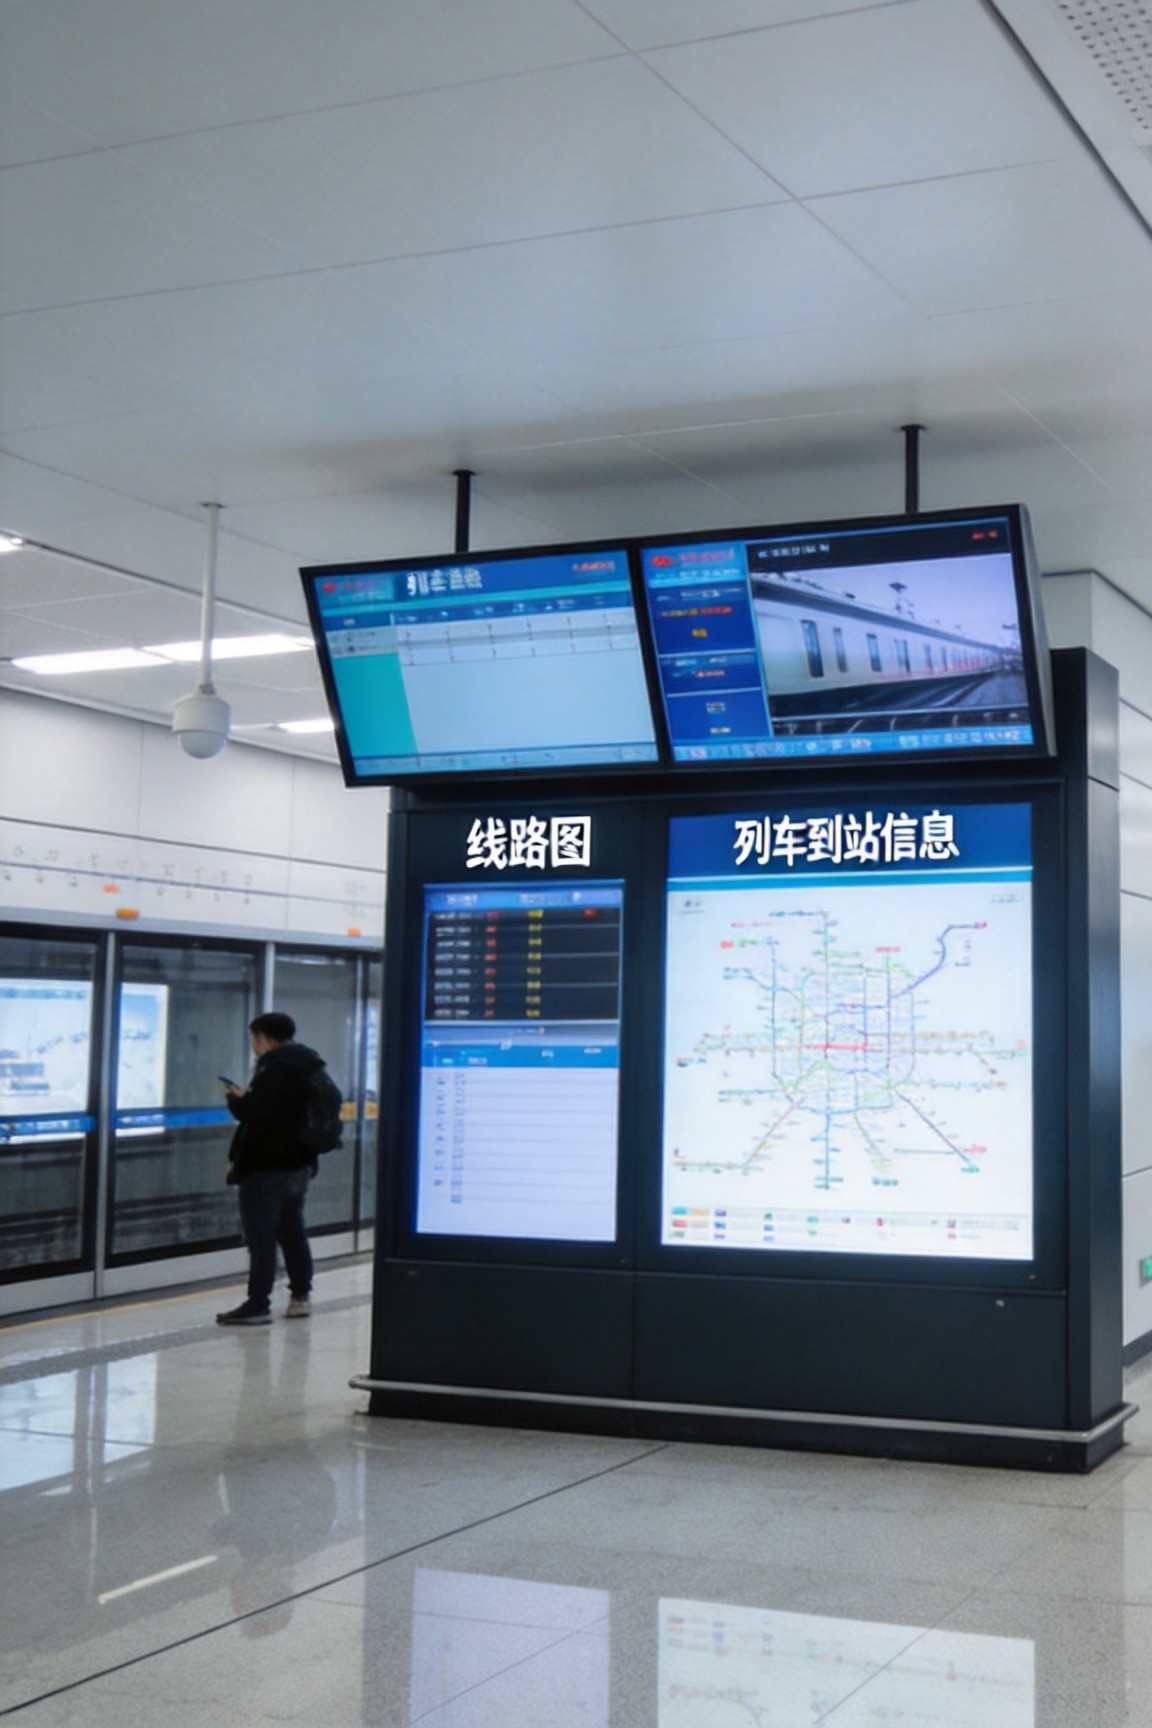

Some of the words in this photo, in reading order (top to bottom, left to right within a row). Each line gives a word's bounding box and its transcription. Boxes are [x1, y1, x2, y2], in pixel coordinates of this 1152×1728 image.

[466, 815, 591, 870] 线路图
[733, 810, 960, 866] 列车到站信息
